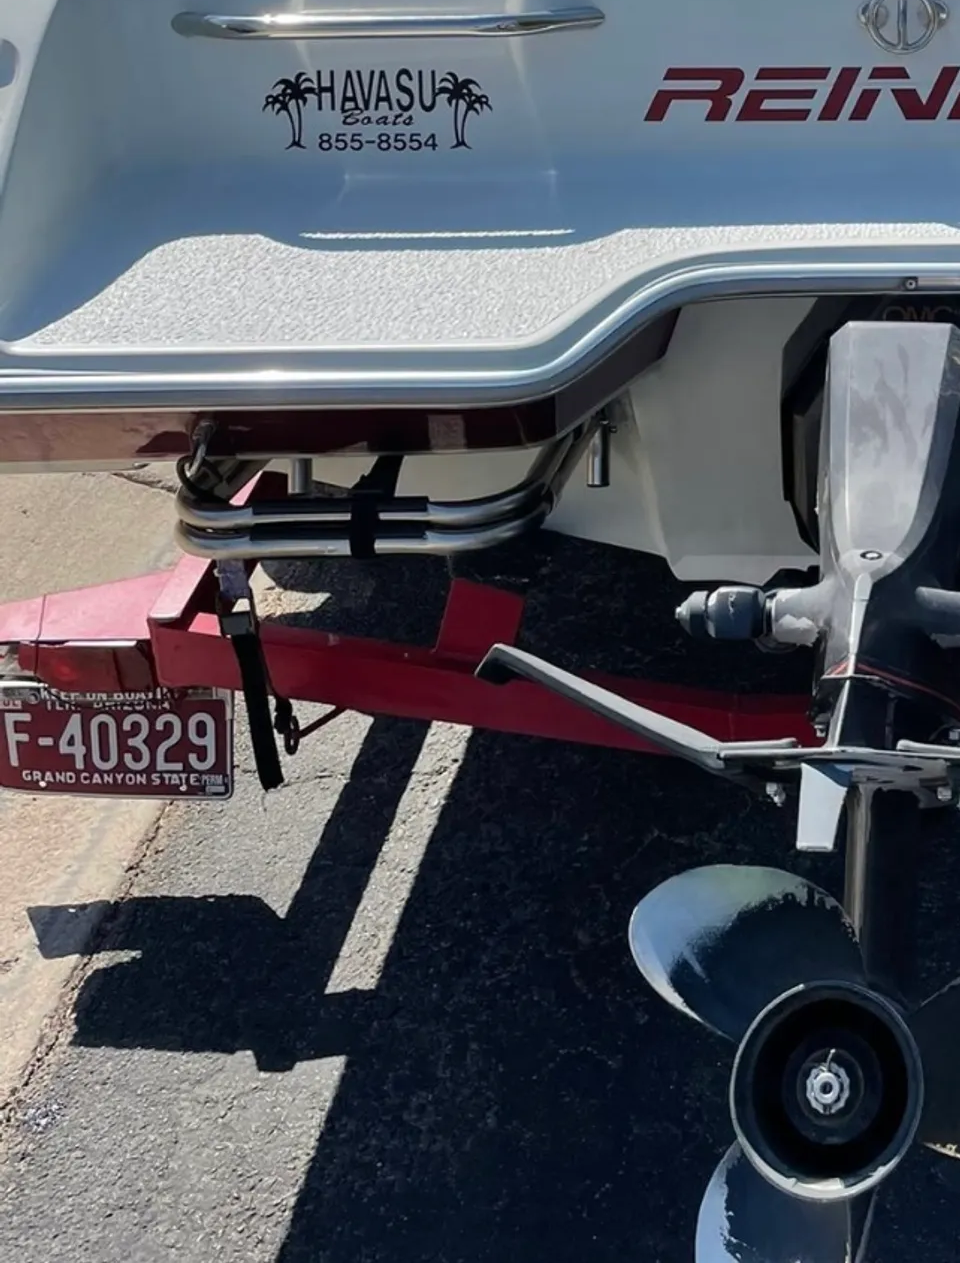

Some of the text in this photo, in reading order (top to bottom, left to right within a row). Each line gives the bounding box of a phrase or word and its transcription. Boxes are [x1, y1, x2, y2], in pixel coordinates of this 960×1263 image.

[316, 68, 437, 113] HAVASU
[341, 107, 416, 127] Boats
[317, 132, 439, 152] 855-8554
[4, 712, 217, 772] F-40329
[22, 769, 201, 786] GRAND CANYON STATE
